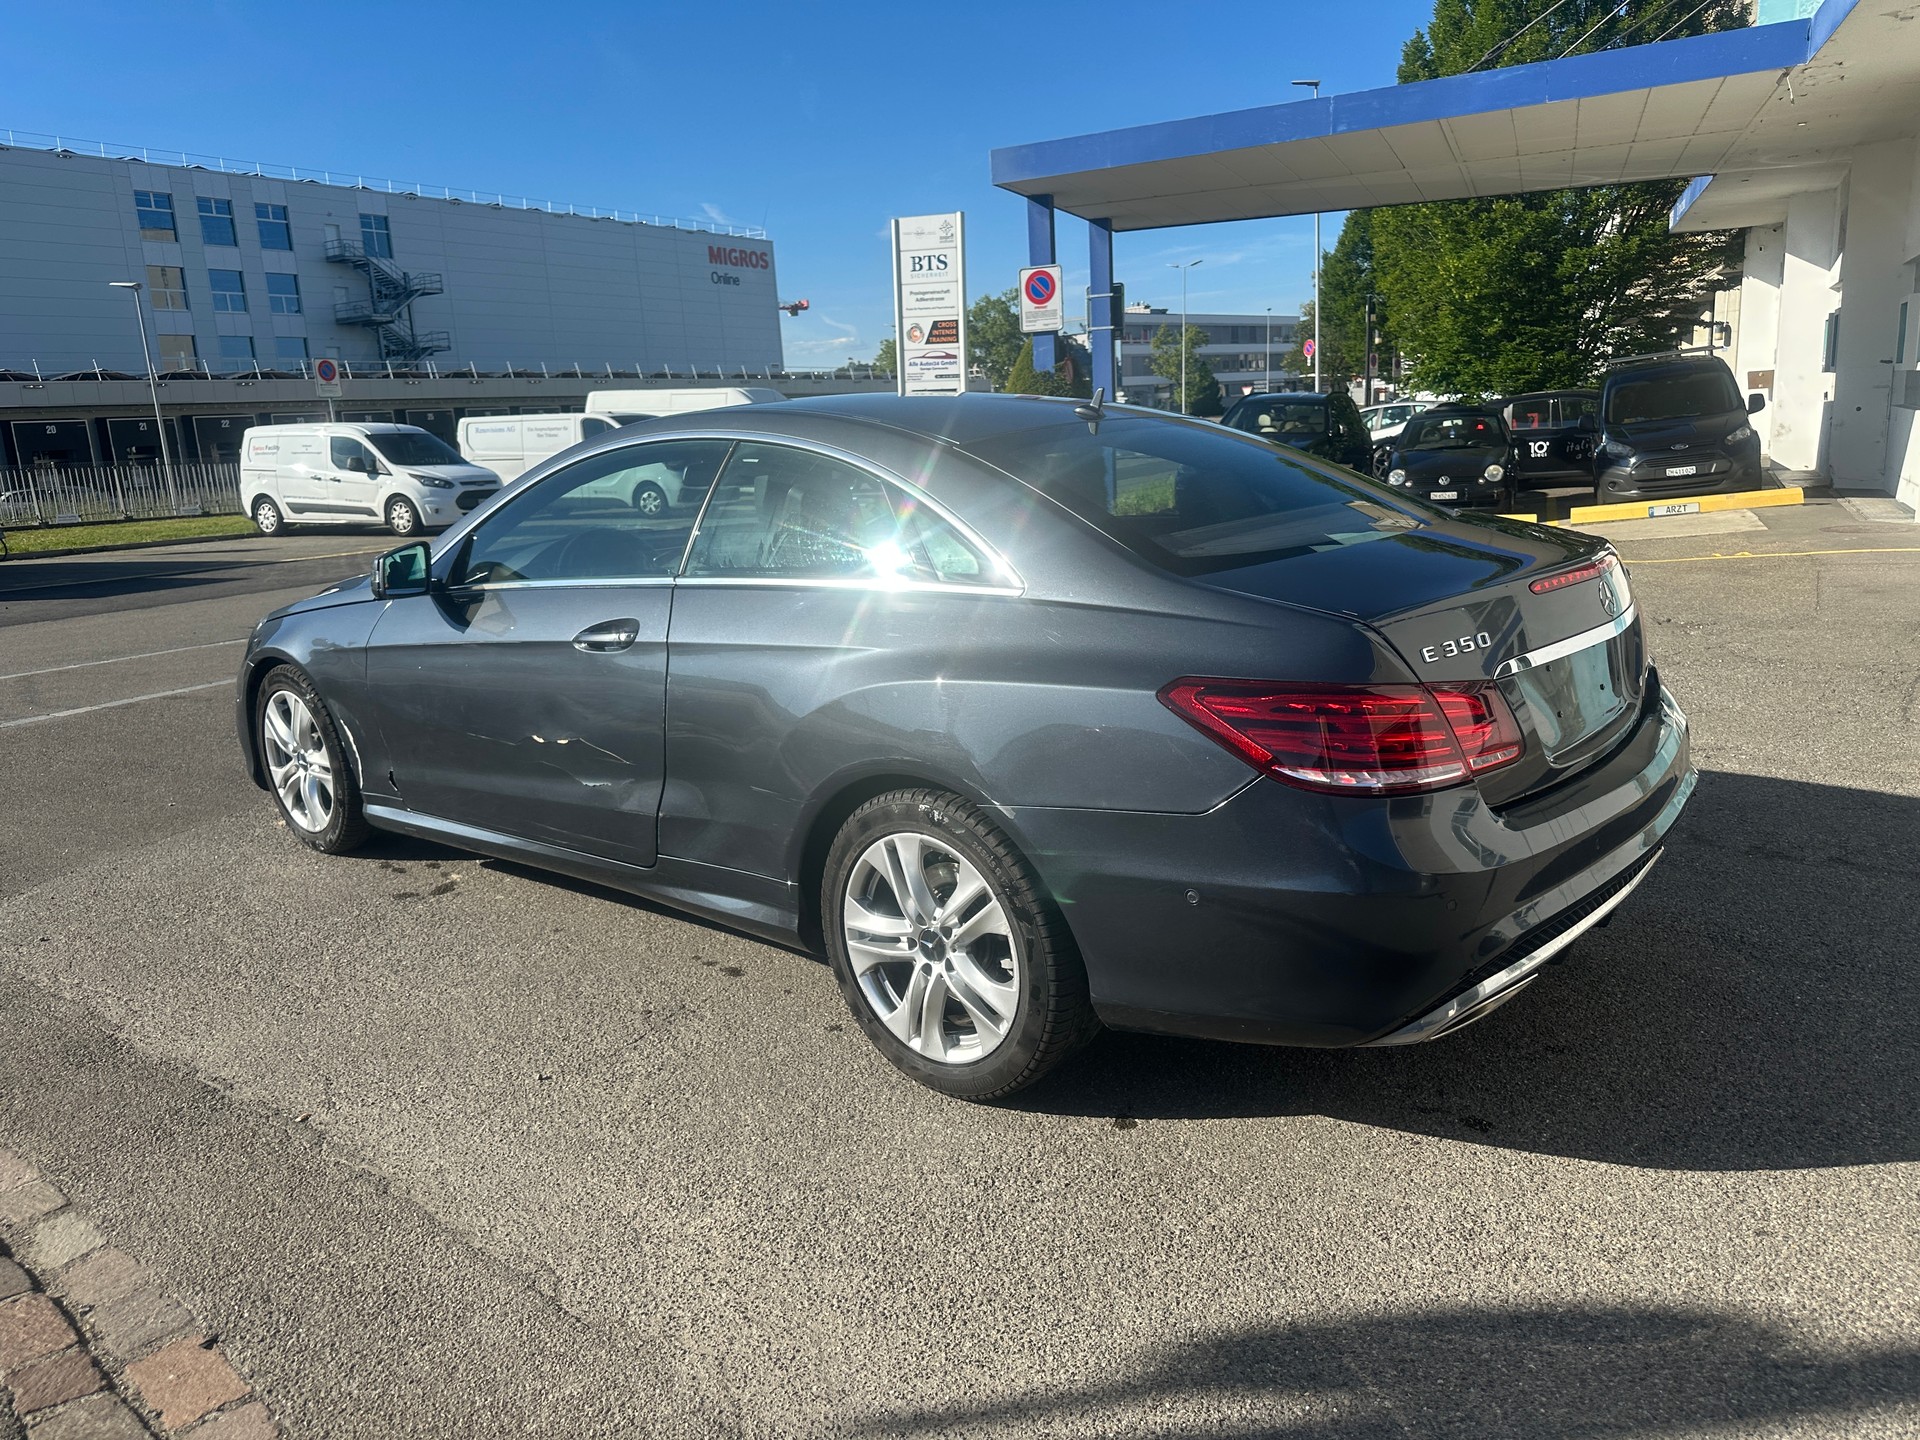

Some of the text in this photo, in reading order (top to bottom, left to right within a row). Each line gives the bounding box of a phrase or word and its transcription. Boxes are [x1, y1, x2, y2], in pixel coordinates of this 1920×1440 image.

[708, 245, 769, 270] MIGROS
[910, 254, 948, 272] BTS
[711, 271, 740, 286] Online
[139, 422, 148, 431] 21
[221, 419, 230, 428] 22
[45, 425, 57, 434] 20
[506, 425, 516, 433] AG
[1666, 504, 1688, 514] ARZT
[1420, 631, 1492, 664] E 350
